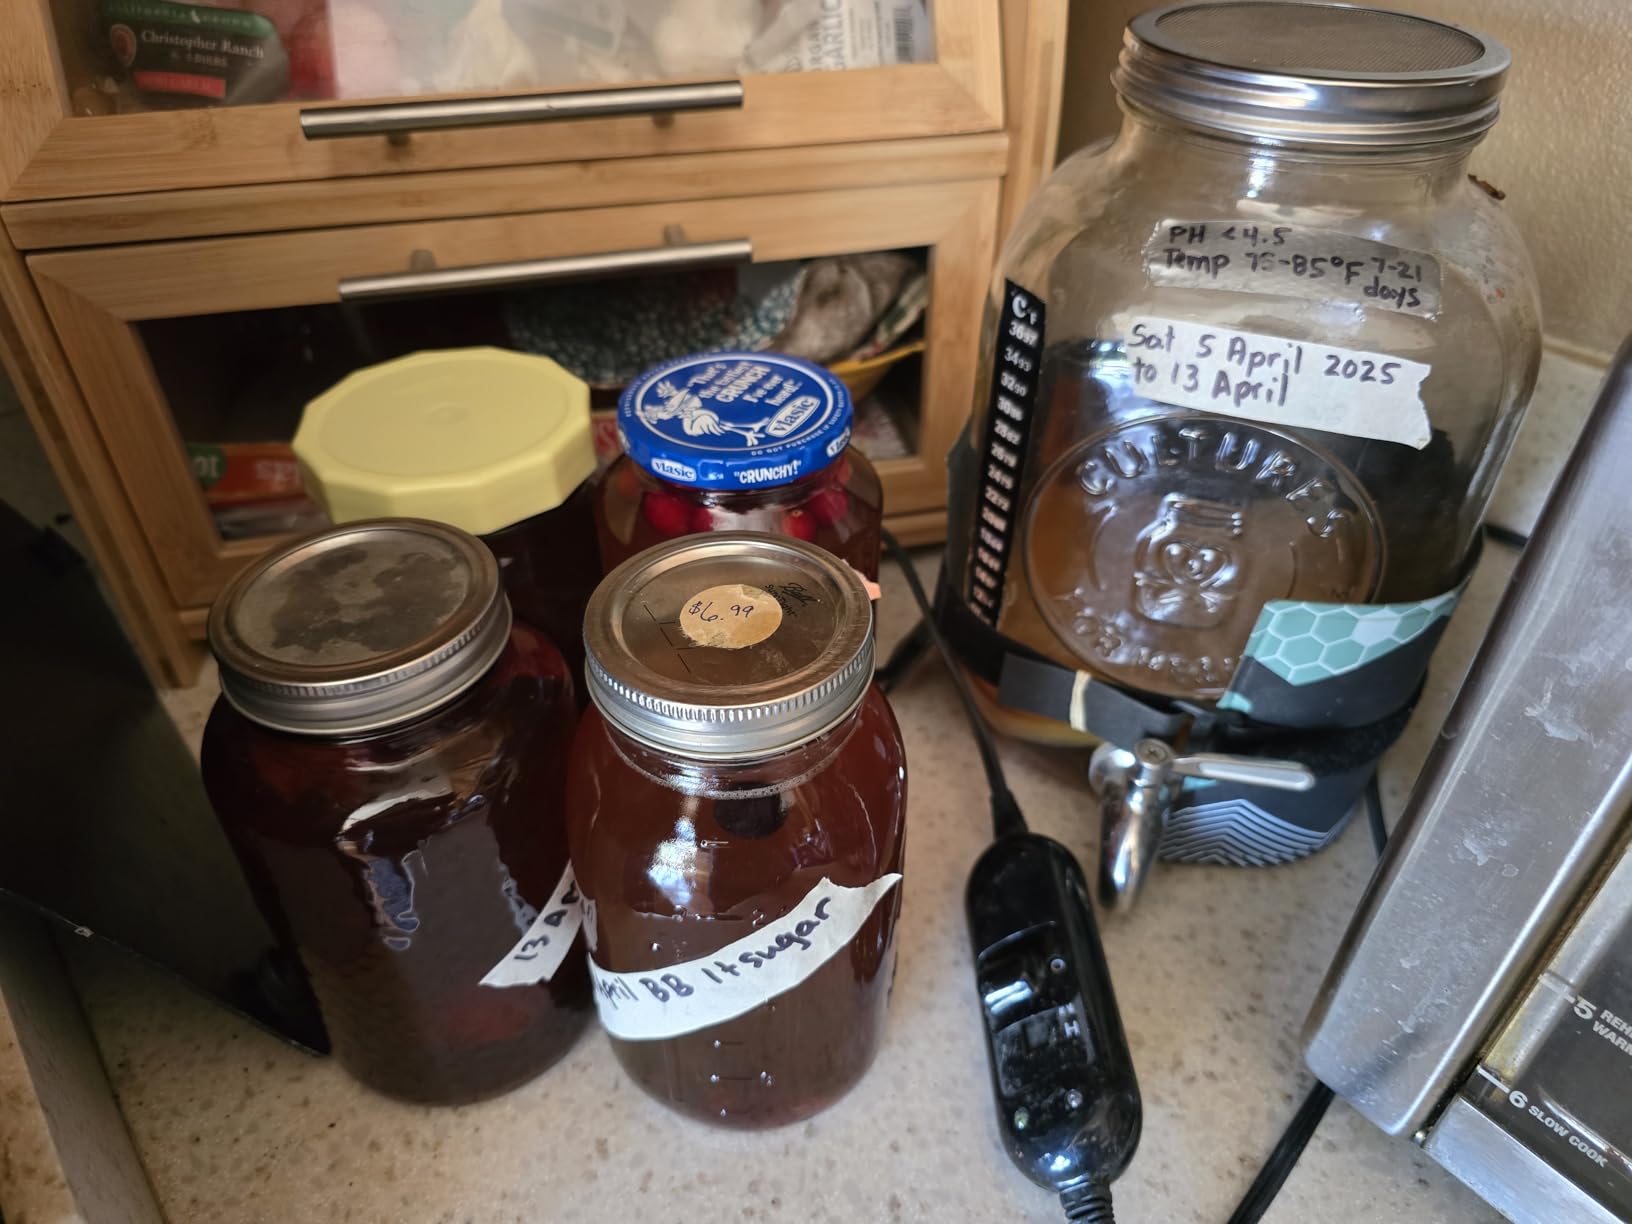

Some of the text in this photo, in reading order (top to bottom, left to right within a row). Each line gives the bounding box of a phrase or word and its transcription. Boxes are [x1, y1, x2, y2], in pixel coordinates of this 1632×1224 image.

[141, 29, 218, 52] Christopher
[222, 39, 265, 58] Ranch
[1164, 249, 1230, 279] Temp
[1363, 277, 1421, 308] days
[1128, 323, 1402, 385] Sat 5 April 2025
[716, 365, 771, 402] CRUNCH
[1132, 357, 1288, 407] to 13 April
[688, 600, 754, 622] $6.99
[513, 935, 551, 960] 13
[639, 973, 695, 1003] BB
[1574, 995, 1632, 1040] 5 REH
[1509, 1091, 1608, 1168] 6 SLOW COOK
